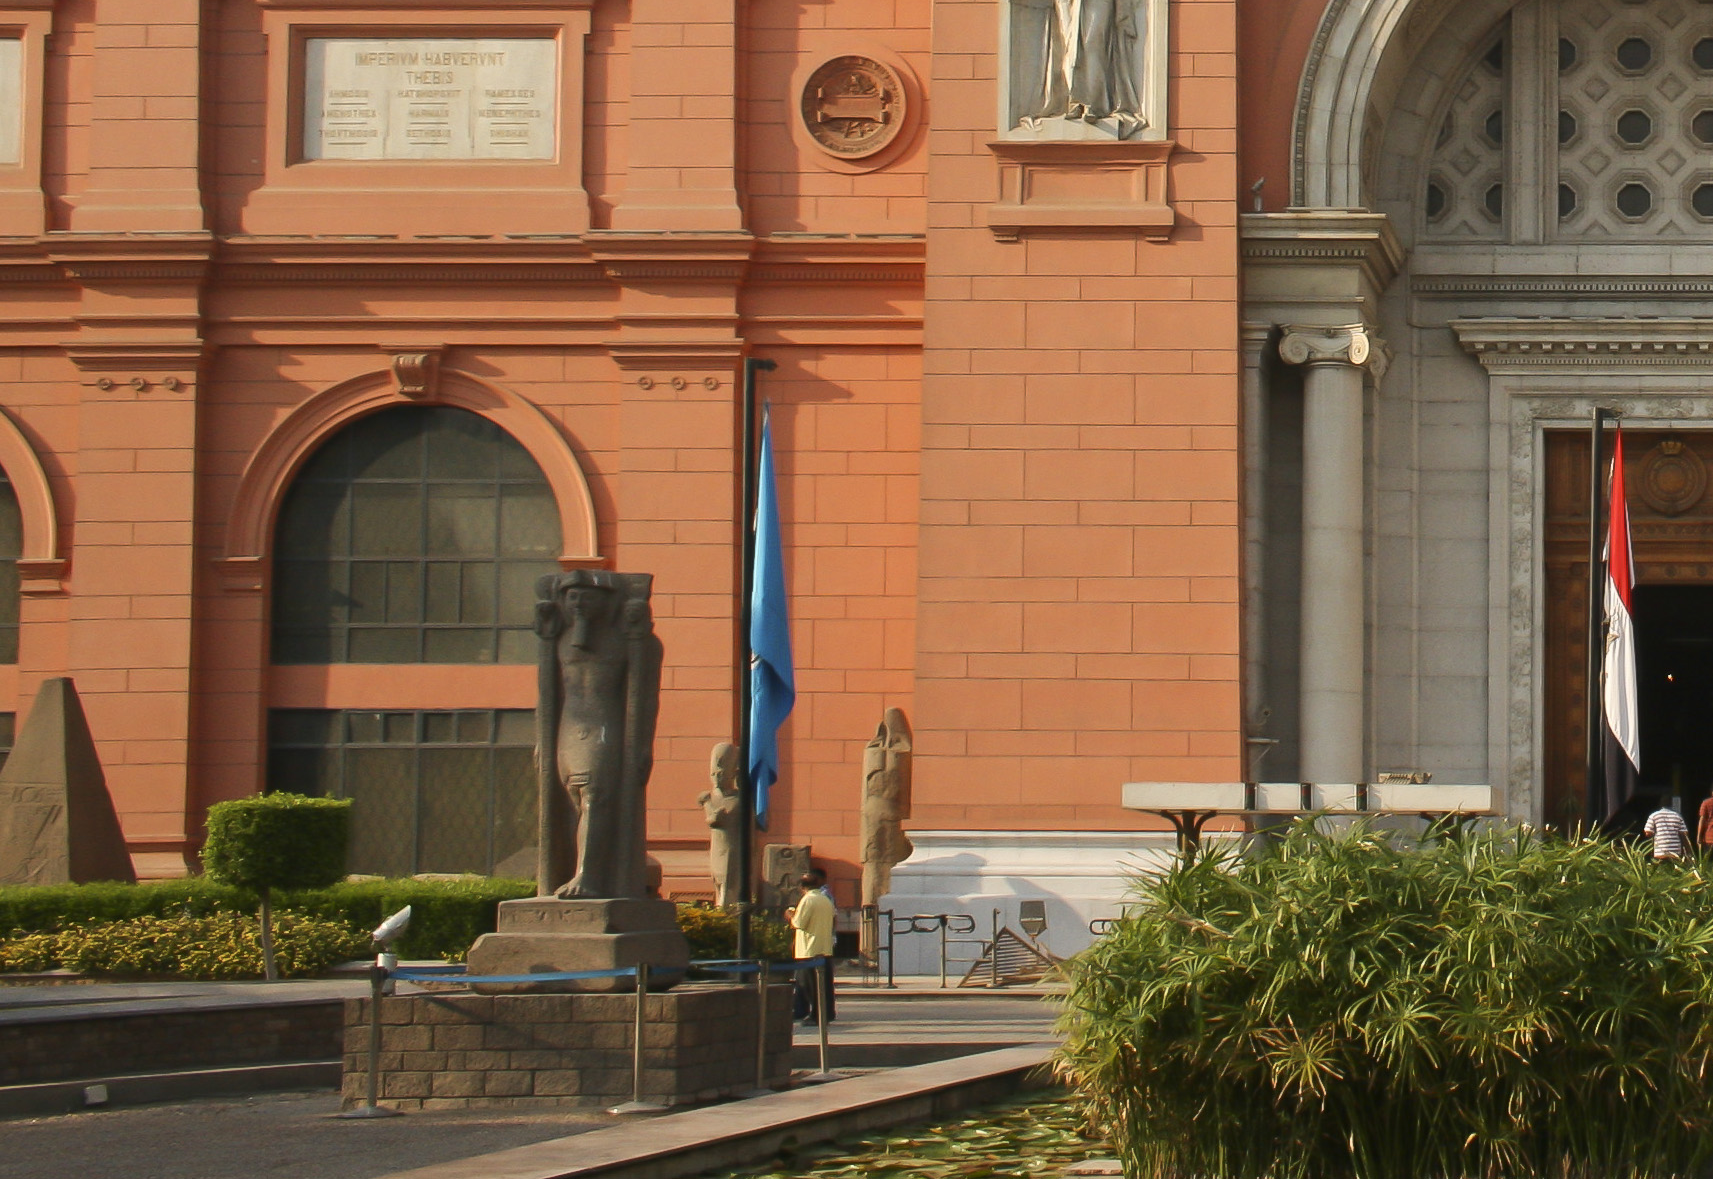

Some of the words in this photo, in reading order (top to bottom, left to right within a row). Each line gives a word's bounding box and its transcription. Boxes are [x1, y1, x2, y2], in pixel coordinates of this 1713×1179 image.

[355, 51, 419, 67] IMPERIVM
[423, 51, 505, 67] HABVERVNT
[405, 70, 454, 85] THEBIS
